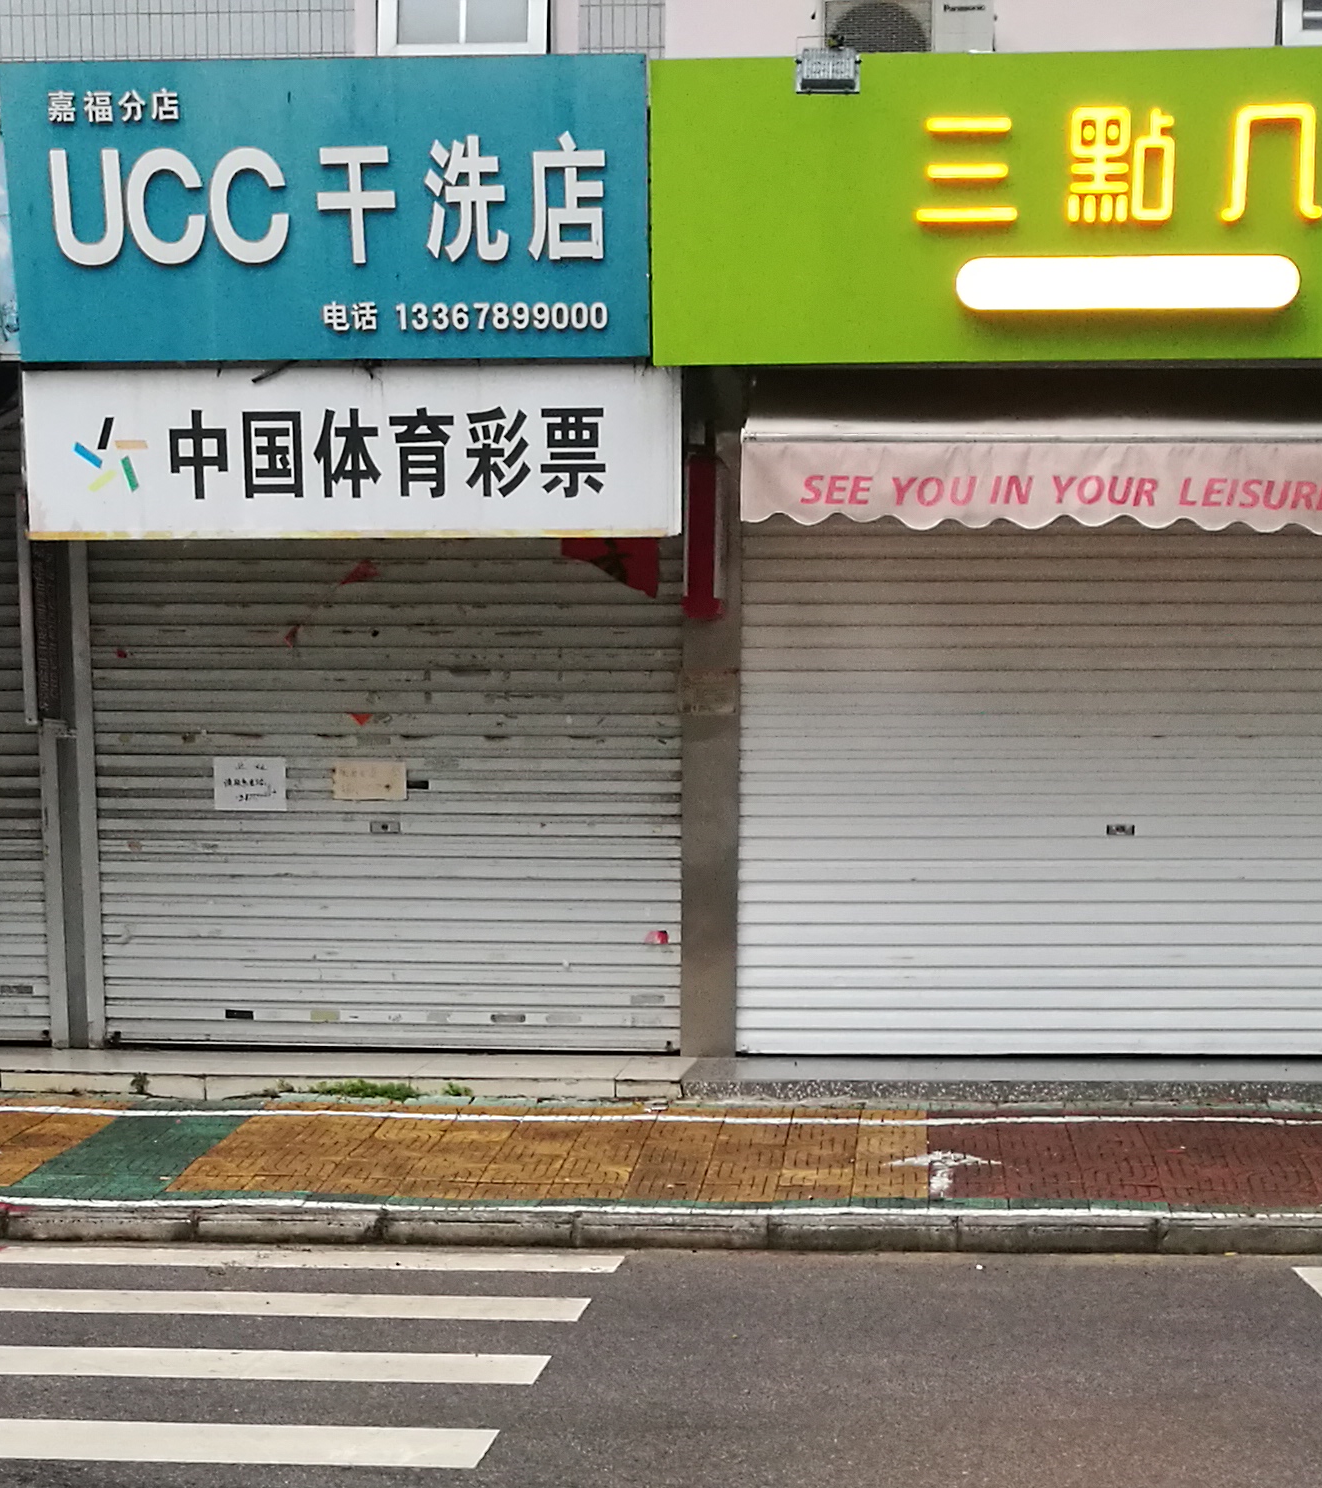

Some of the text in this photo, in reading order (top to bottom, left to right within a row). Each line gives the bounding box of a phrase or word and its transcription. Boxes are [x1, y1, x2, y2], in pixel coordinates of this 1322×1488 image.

[943, 4, 986, 12] Panasonic
[47, 87, 179, 124] 嘉福分店
[48, 130, 607, 266] UCC 干洗店
[322, 299, 608, 331] 电话 13367899000
[168, 406, 606, 500] 中国体育彩票
[798, 474, 874, 507] SEE
[890, 474, 976, 508] YOU
[988, 474, 1034, 507] IN
[1050, 474, 1158, 509] YOUR
